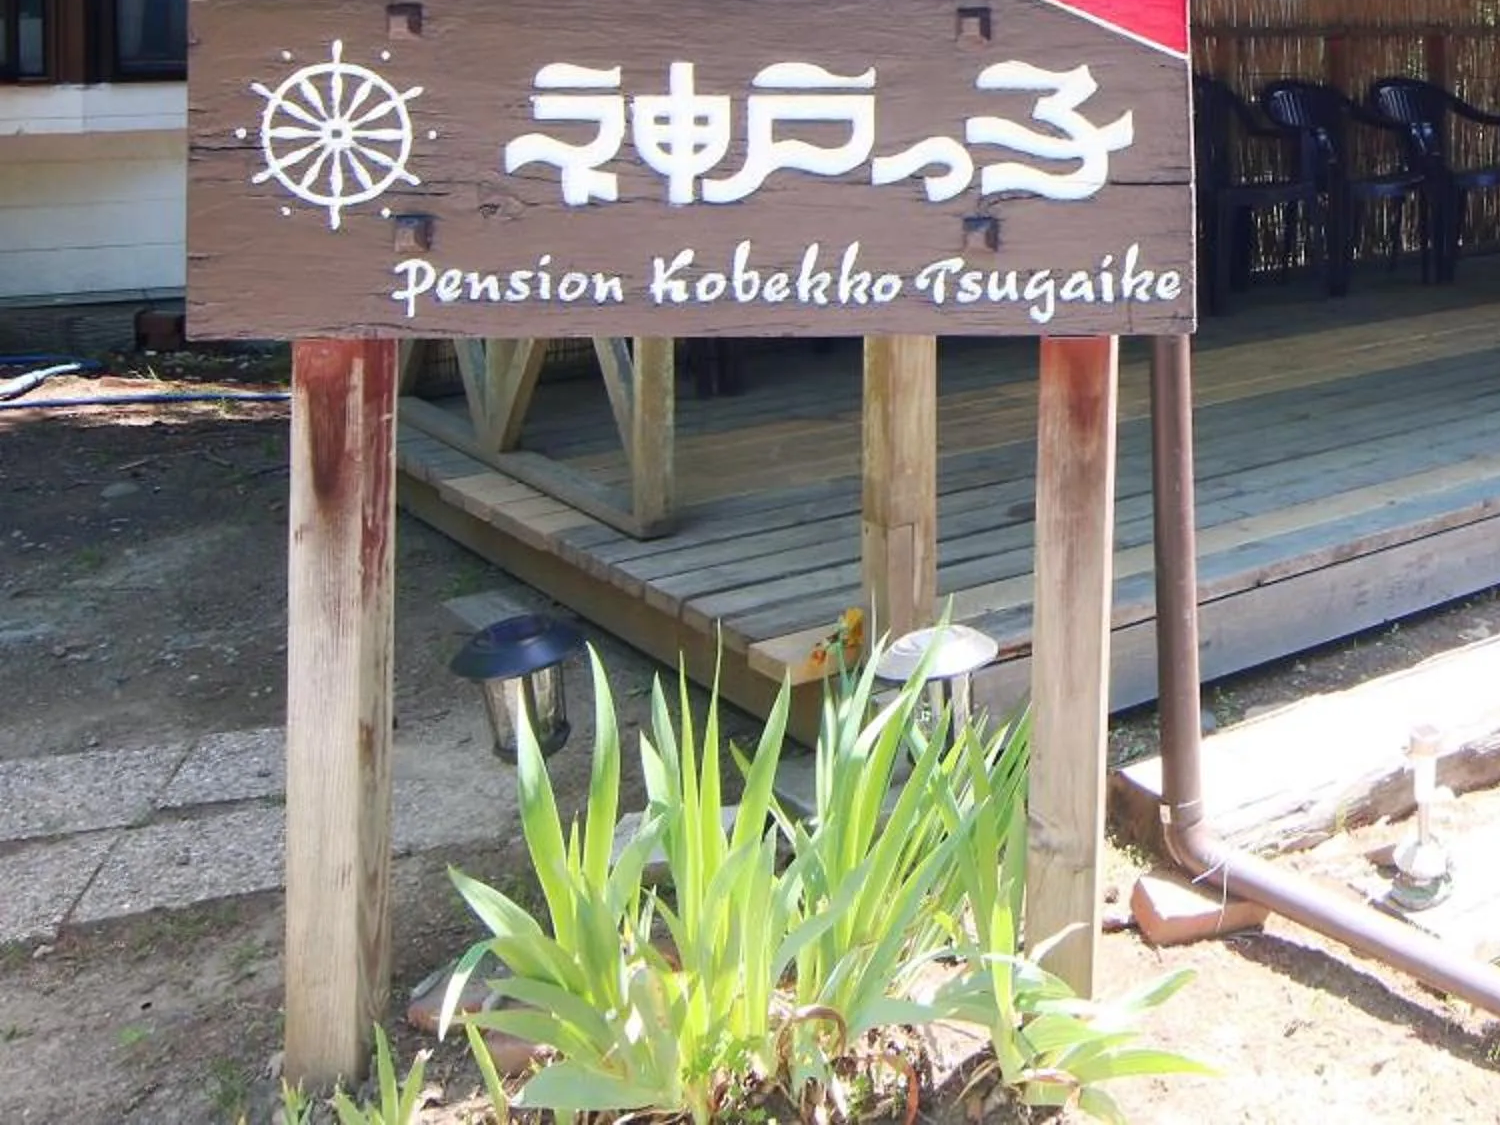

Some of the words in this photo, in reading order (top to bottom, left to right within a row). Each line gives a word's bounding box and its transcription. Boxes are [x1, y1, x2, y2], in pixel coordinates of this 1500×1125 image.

[505, 60, 1135, 206] 神戸っ子
[391, 256, 625, 318] Pension
[649, 240, 904, 305] Kobekko
[914, 241, 1182, 324] Tsugaike
